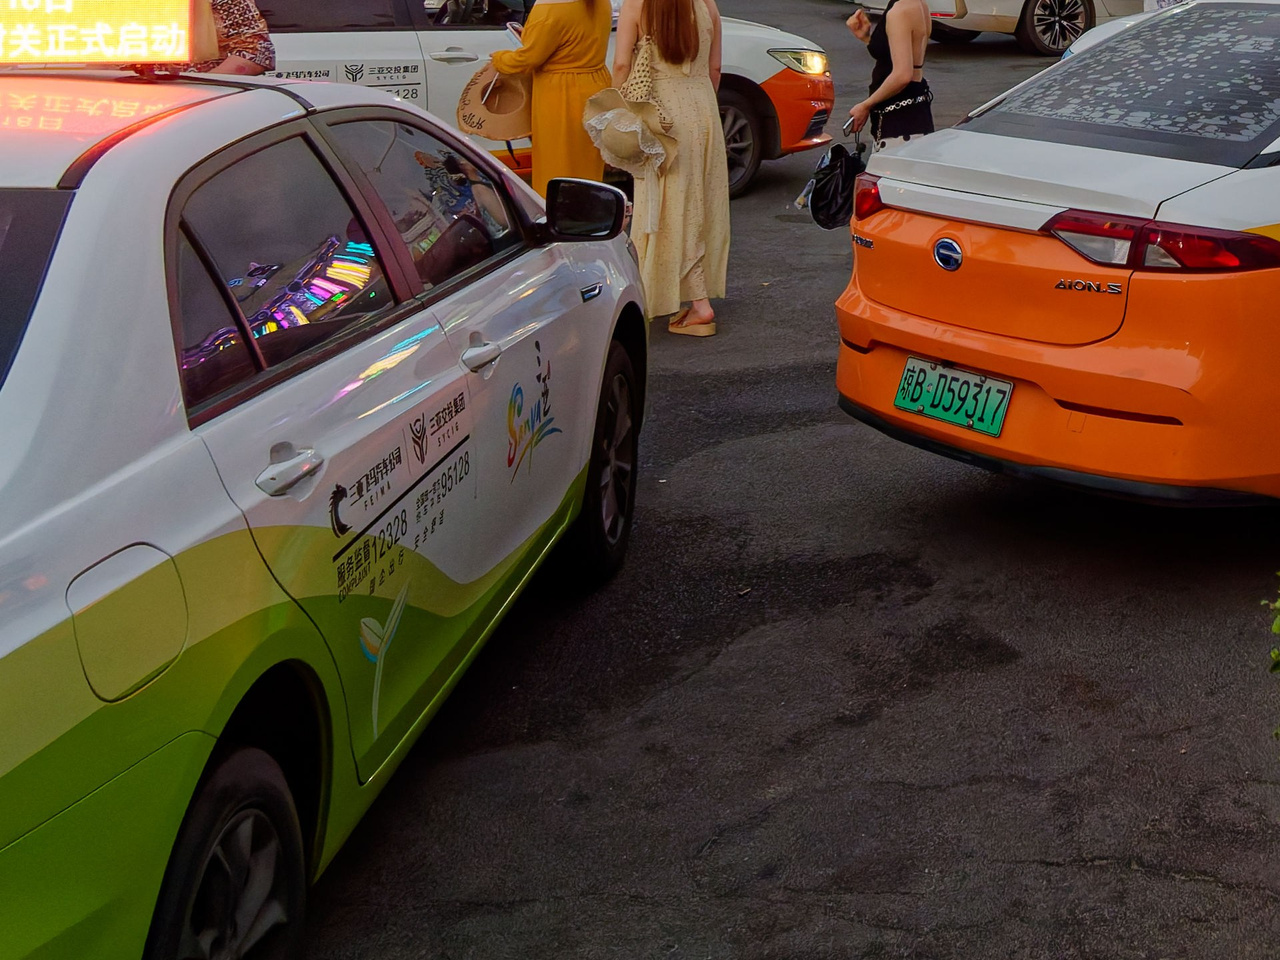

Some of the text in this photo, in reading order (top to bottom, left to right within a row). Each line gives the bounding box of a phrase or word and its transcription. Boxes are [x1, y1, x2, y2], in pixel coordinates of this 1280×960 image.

[368, 64, 419, 75] 三亚交投集团
[441, 450, 470, 499] 95128
[372, 509, 408, 564] 12328
